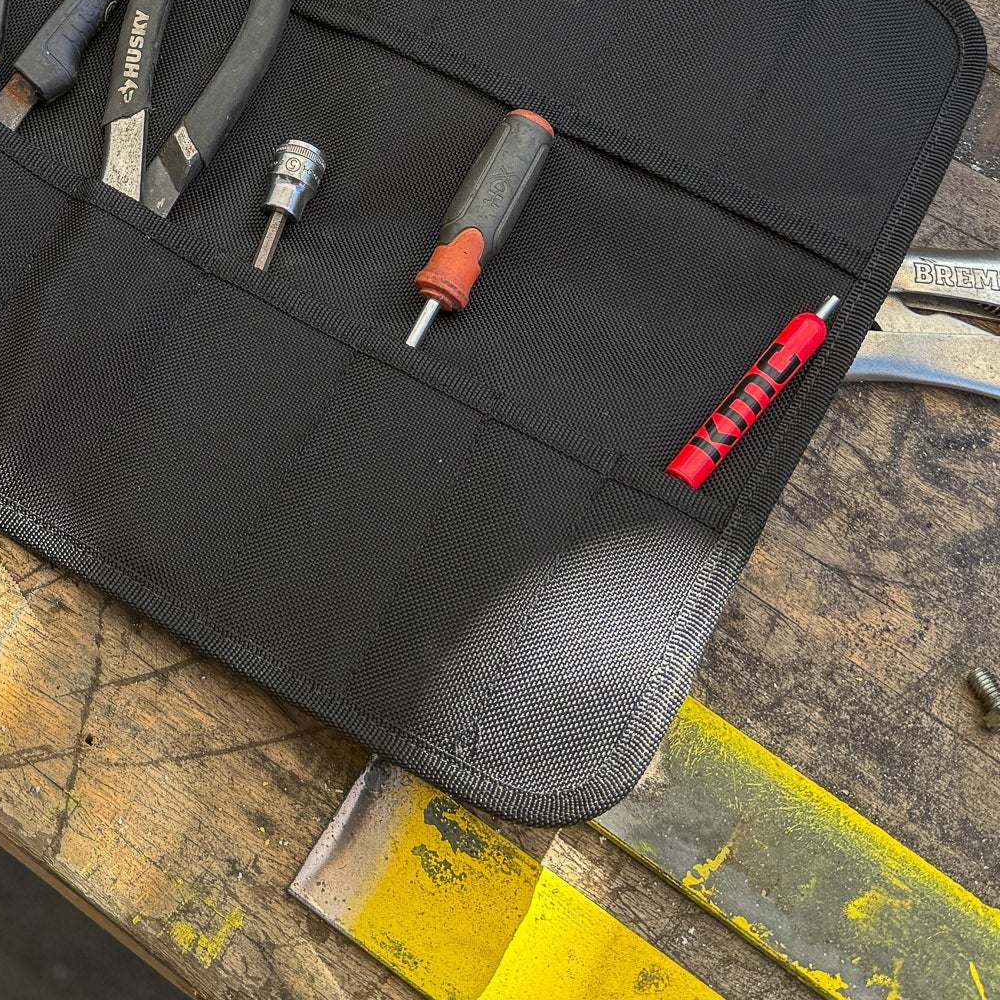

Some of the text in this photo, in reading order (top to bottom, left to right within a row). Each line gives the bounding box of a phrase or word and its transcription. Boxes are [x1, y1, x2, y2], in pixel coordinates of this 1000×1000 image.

[122, 9, 150, 79] HUSKY
[482, 164, 519, 208] HDX
[913, 261, 1000, 292] BREM
